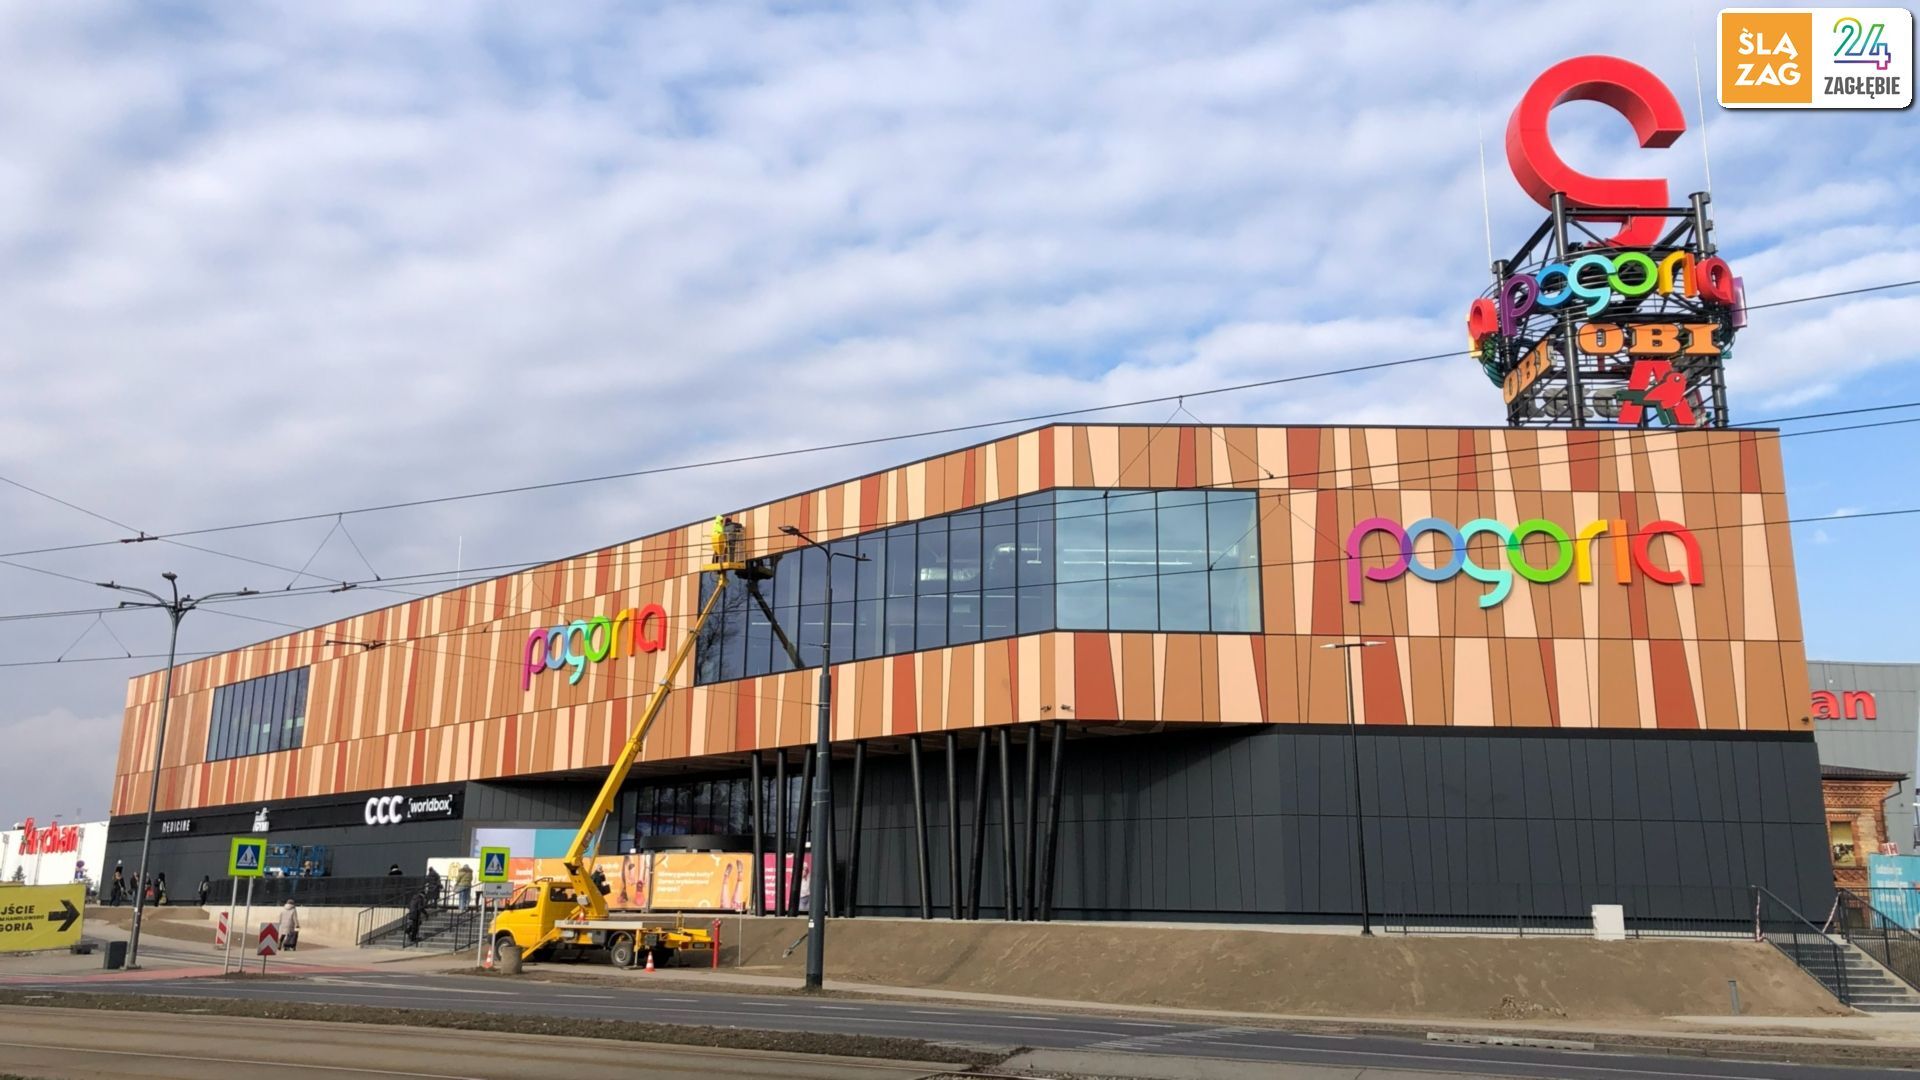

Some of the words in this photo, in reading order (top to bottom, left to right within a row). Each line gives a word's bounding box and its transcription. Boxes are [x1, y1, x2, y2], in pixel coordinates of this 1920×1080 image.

[1502, 250, 1736, 337] pogoria
[1577, 322, 1721, 357] OBI
[1503, 340, 1551, 405] OBI
[1346, 517, 1704, 609] pogoria
[523, 603, 667, 691] pogoria
[162, 819, 191, 833] MEDICINE
[365, 795, 404, 825] CCC
